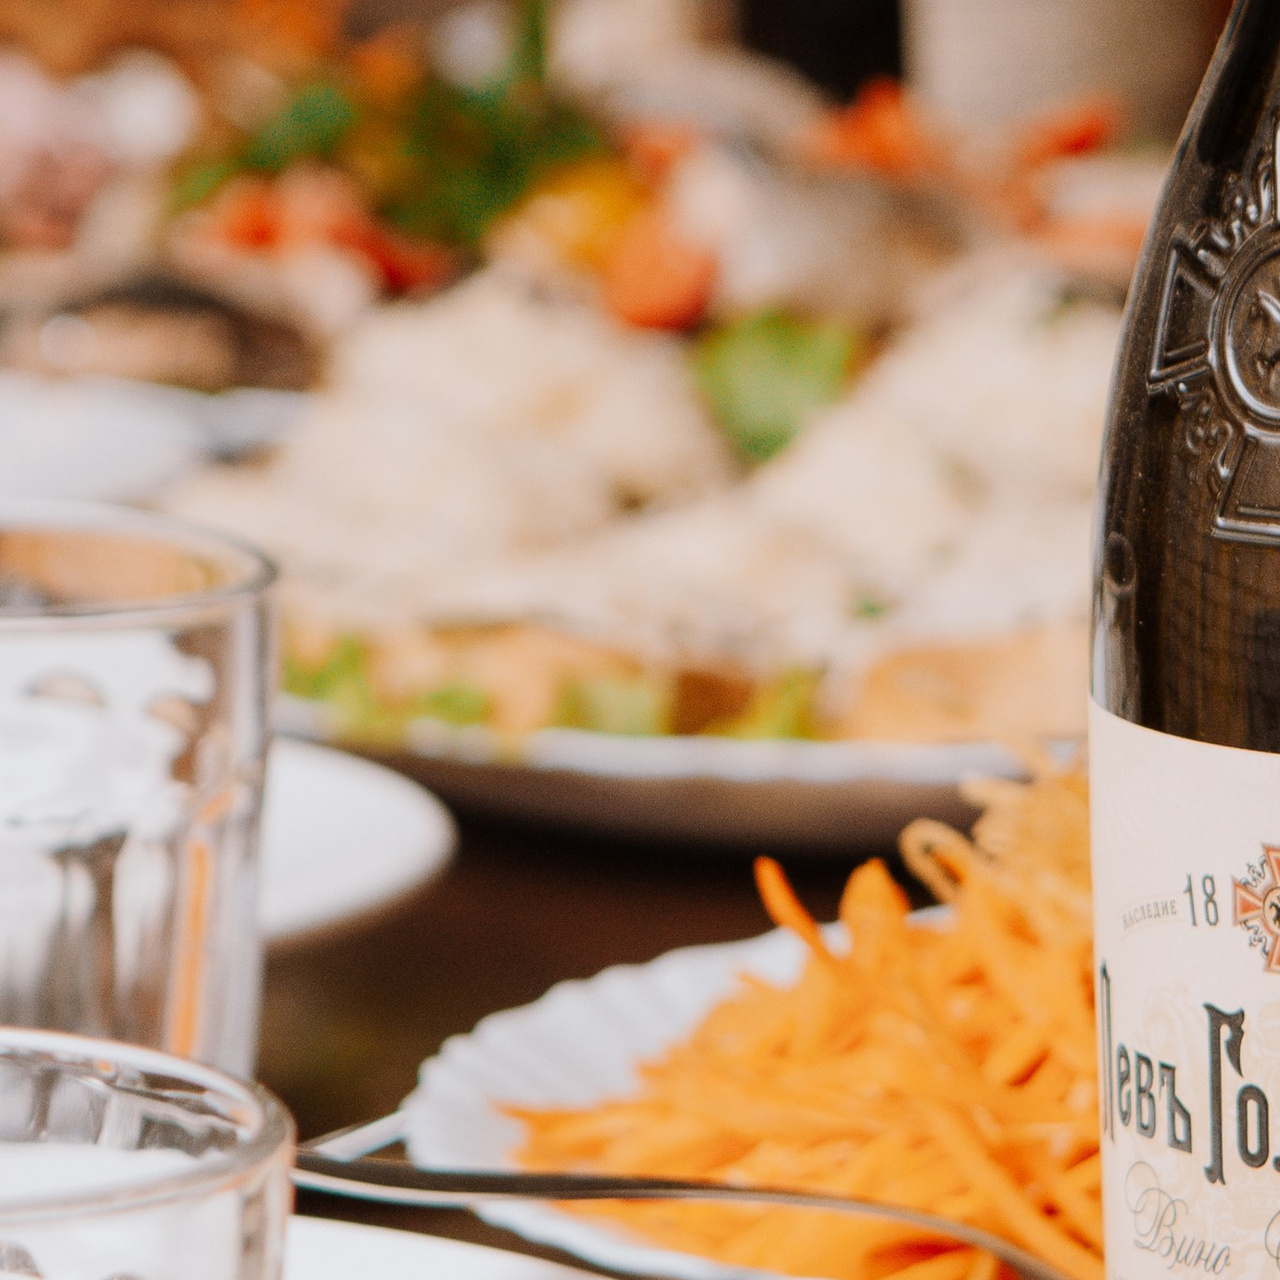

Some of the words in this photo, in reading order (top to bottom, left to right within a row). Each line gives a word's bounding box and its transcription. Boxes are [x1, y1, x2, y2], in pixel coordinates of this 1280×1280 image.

[1120, 899, 1178, 931] НАСЛЕДИЕ
[1183, 872, 1220, 928] 18
[1124, 1160, 1232, 1276] Вино
